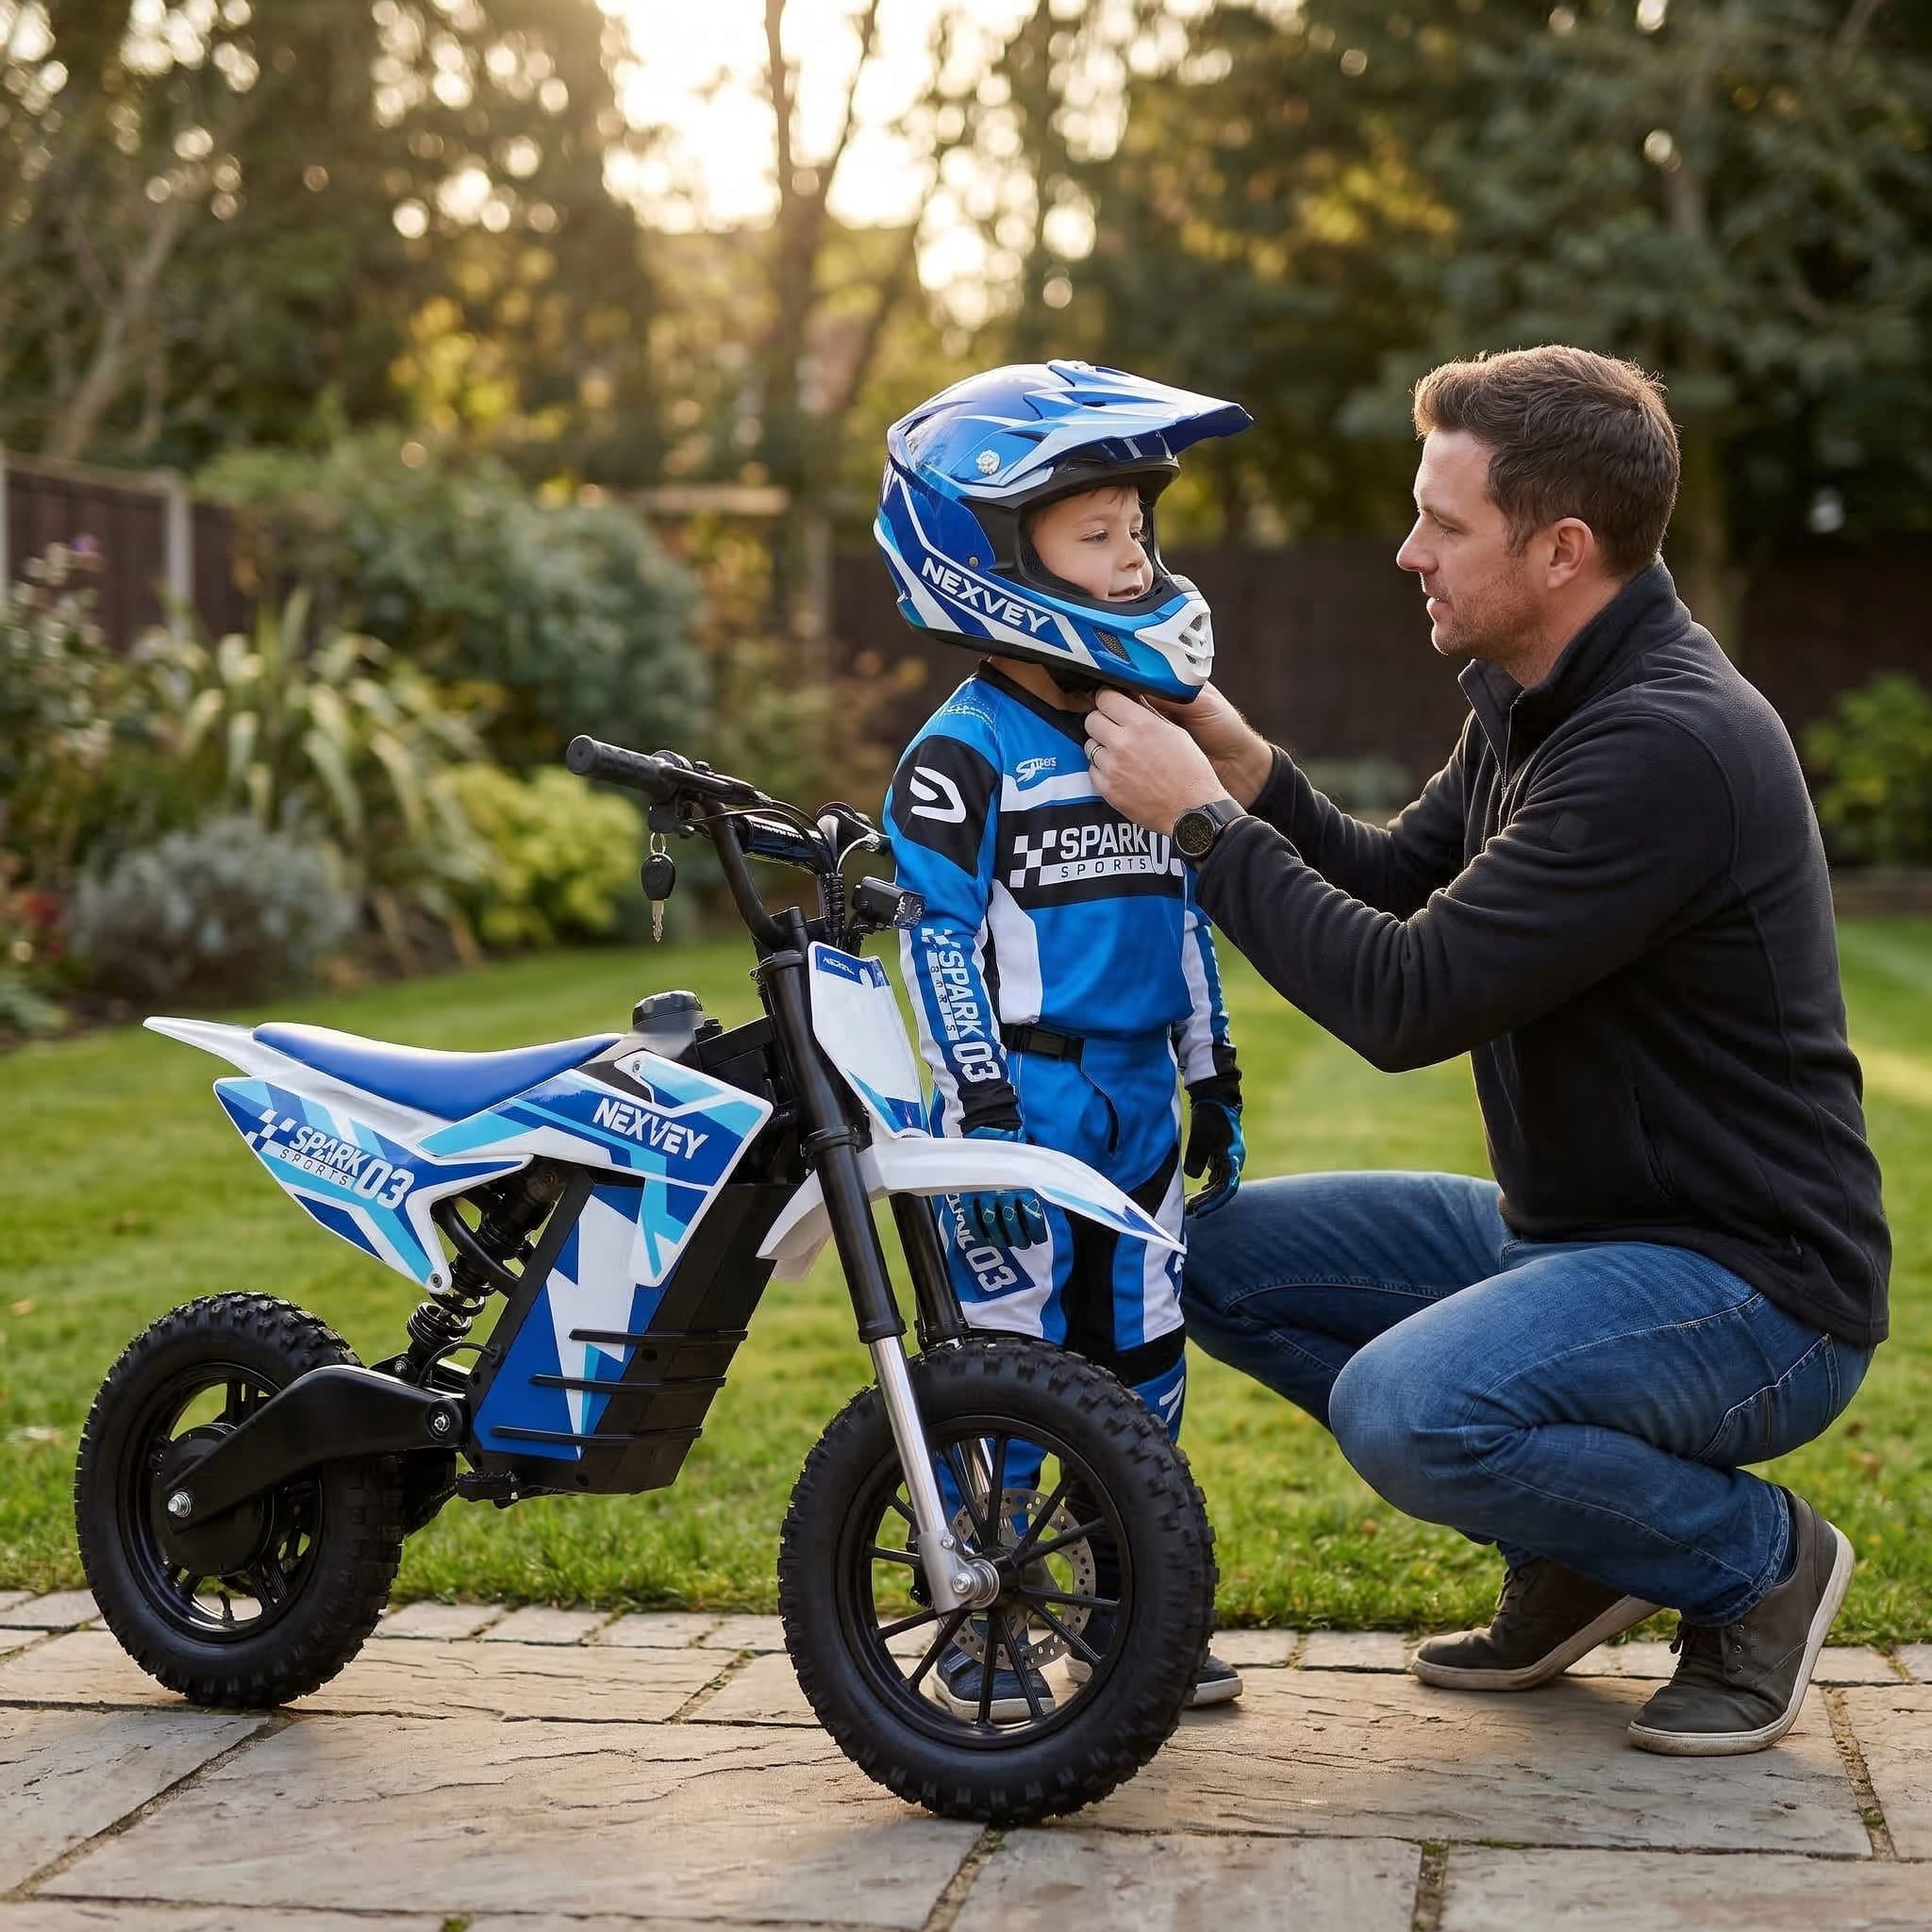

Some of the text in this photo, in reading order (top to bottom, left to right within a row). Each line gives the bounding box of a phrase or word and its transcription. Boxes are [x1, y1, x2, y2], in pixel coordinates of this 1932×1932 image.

[921, 557, 1052, 635] NEXVEY
[1059, 823, 1149, 859] SPARK
[1061, 858, 1146, 878] SPORTS
[939, 950, 1001, 1083] SPARK 03
[592, 1097, 709, 1159] NEXVEY
[279, 1149, 349, 1186] SPORTS
[289, 1125, 415, 1209] SPARK 03
[965, 1245, 1018, 1292] 03
